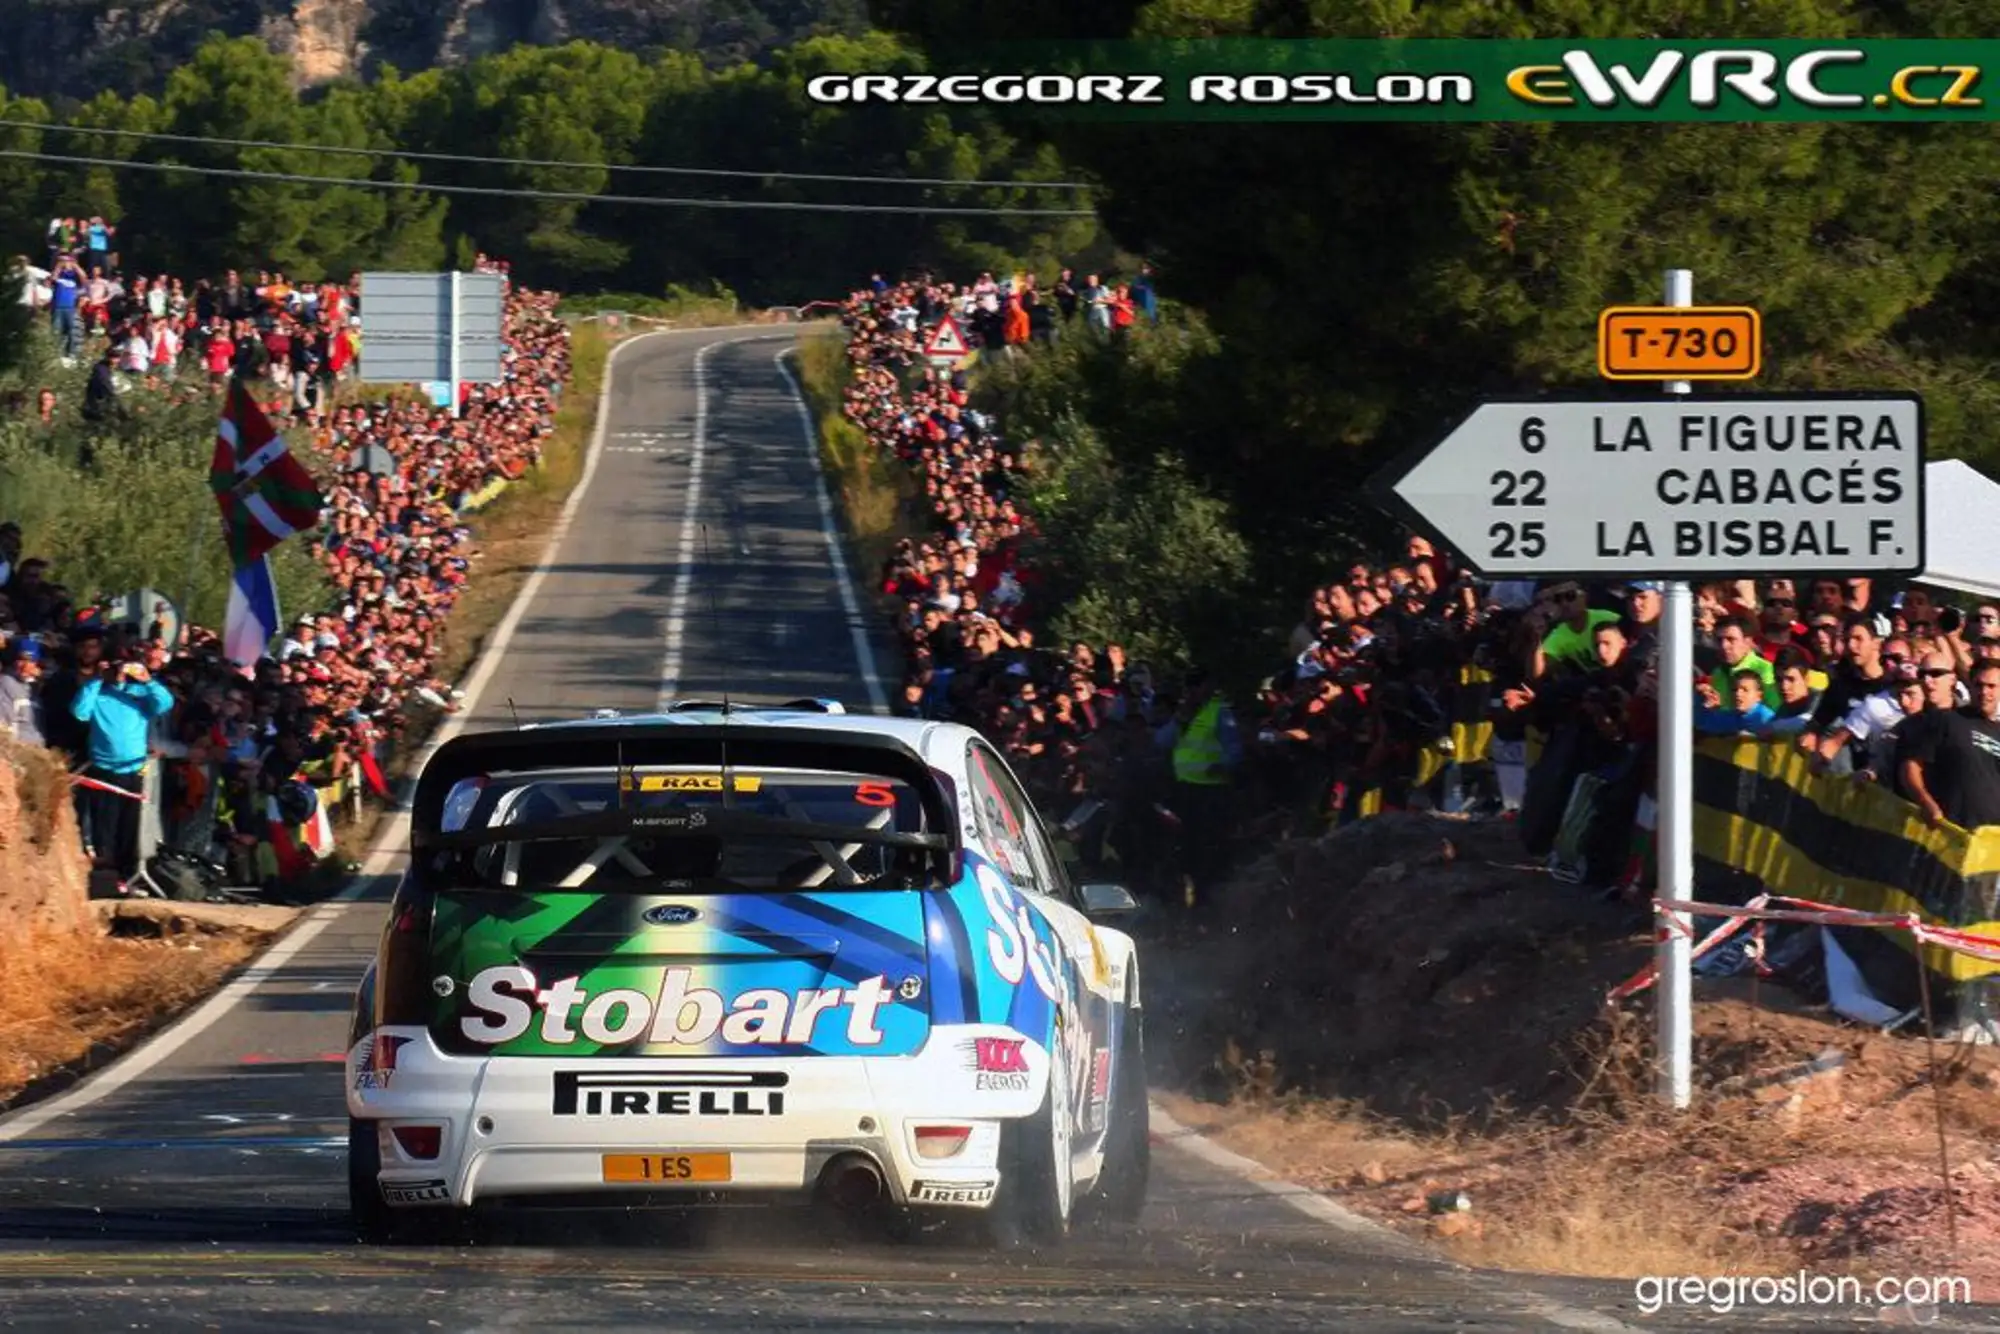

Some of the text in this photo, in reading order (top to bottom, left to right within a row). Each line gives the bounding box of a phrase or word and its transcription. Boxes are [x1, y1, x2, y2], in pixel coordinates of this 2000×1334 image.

[1621, 327, 1738, 359] T-730
[1519, 415, 1902, 454] 6 LA FIGUERA
[1489, 459, 1904, 506] 22 CABACÉS
[1488, 518, 1904, 558] 25 LA BISBAL F.
[855, 780, 896, 807] 5
[460, 964, 896, 1046] Stobart
[552, 1070, 790, 1116] PIRELLI
[641, 1156, 692, 1179] 1 ES
